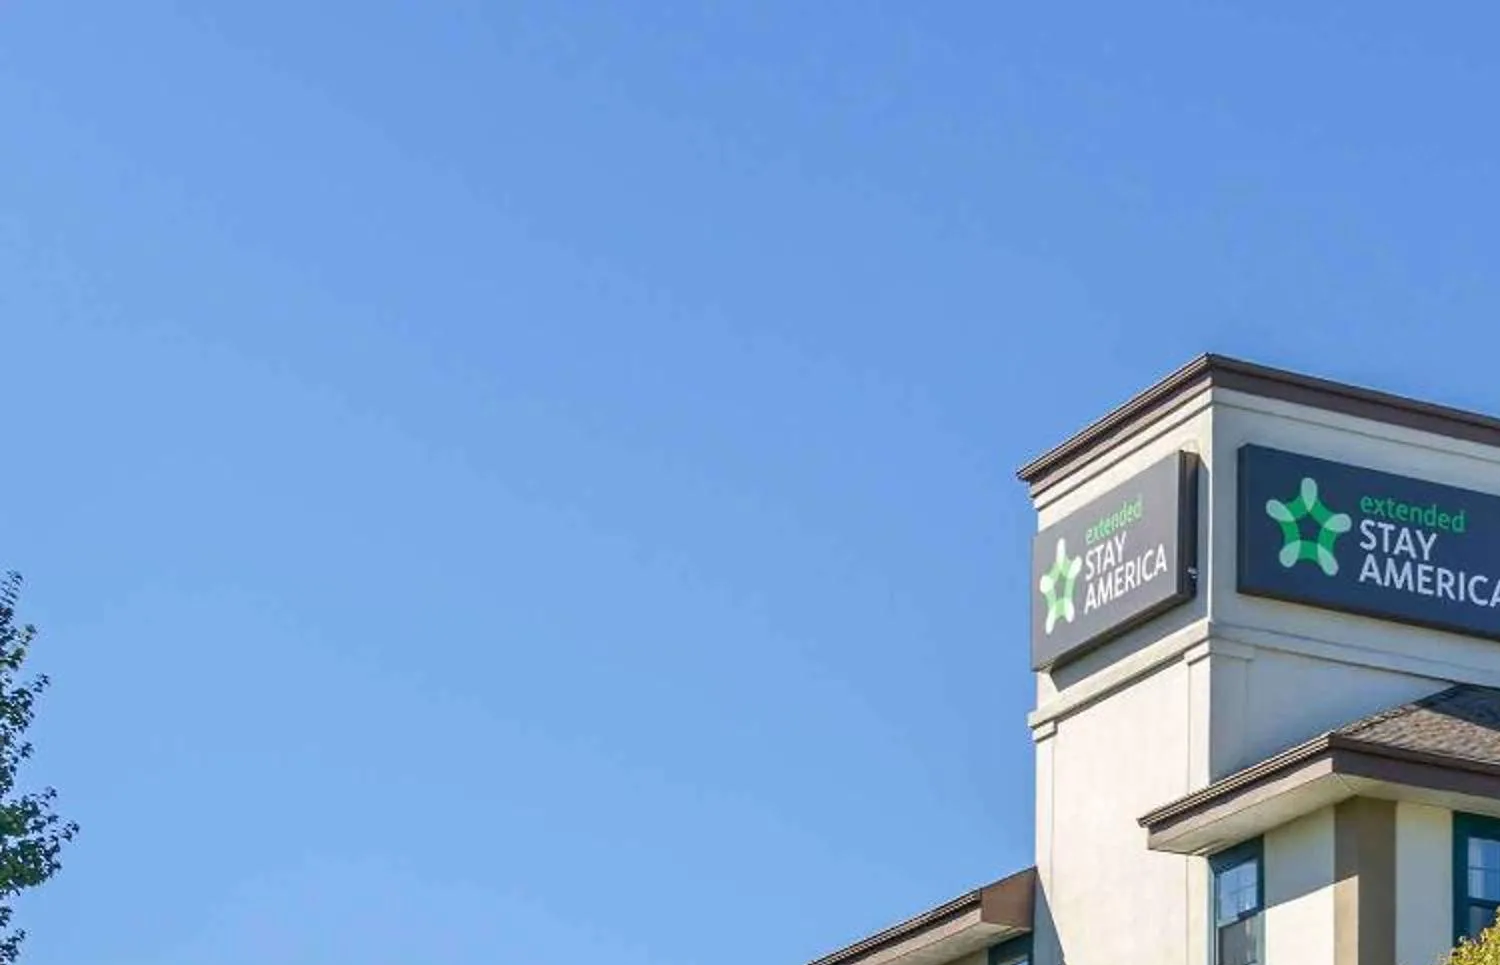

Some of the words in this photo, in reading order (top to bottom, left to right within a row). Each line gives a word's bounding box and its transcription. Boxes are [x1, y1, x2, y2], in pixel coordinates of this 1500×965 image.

[1085, 493, 1143, 543] extended
[1360, 495, 1465, 533] extended
[1084, 530, 1127, 580] STAY
[1359, 520, 1438, 562] STAY
[1084, 544, 1168, 614] AMERICA
